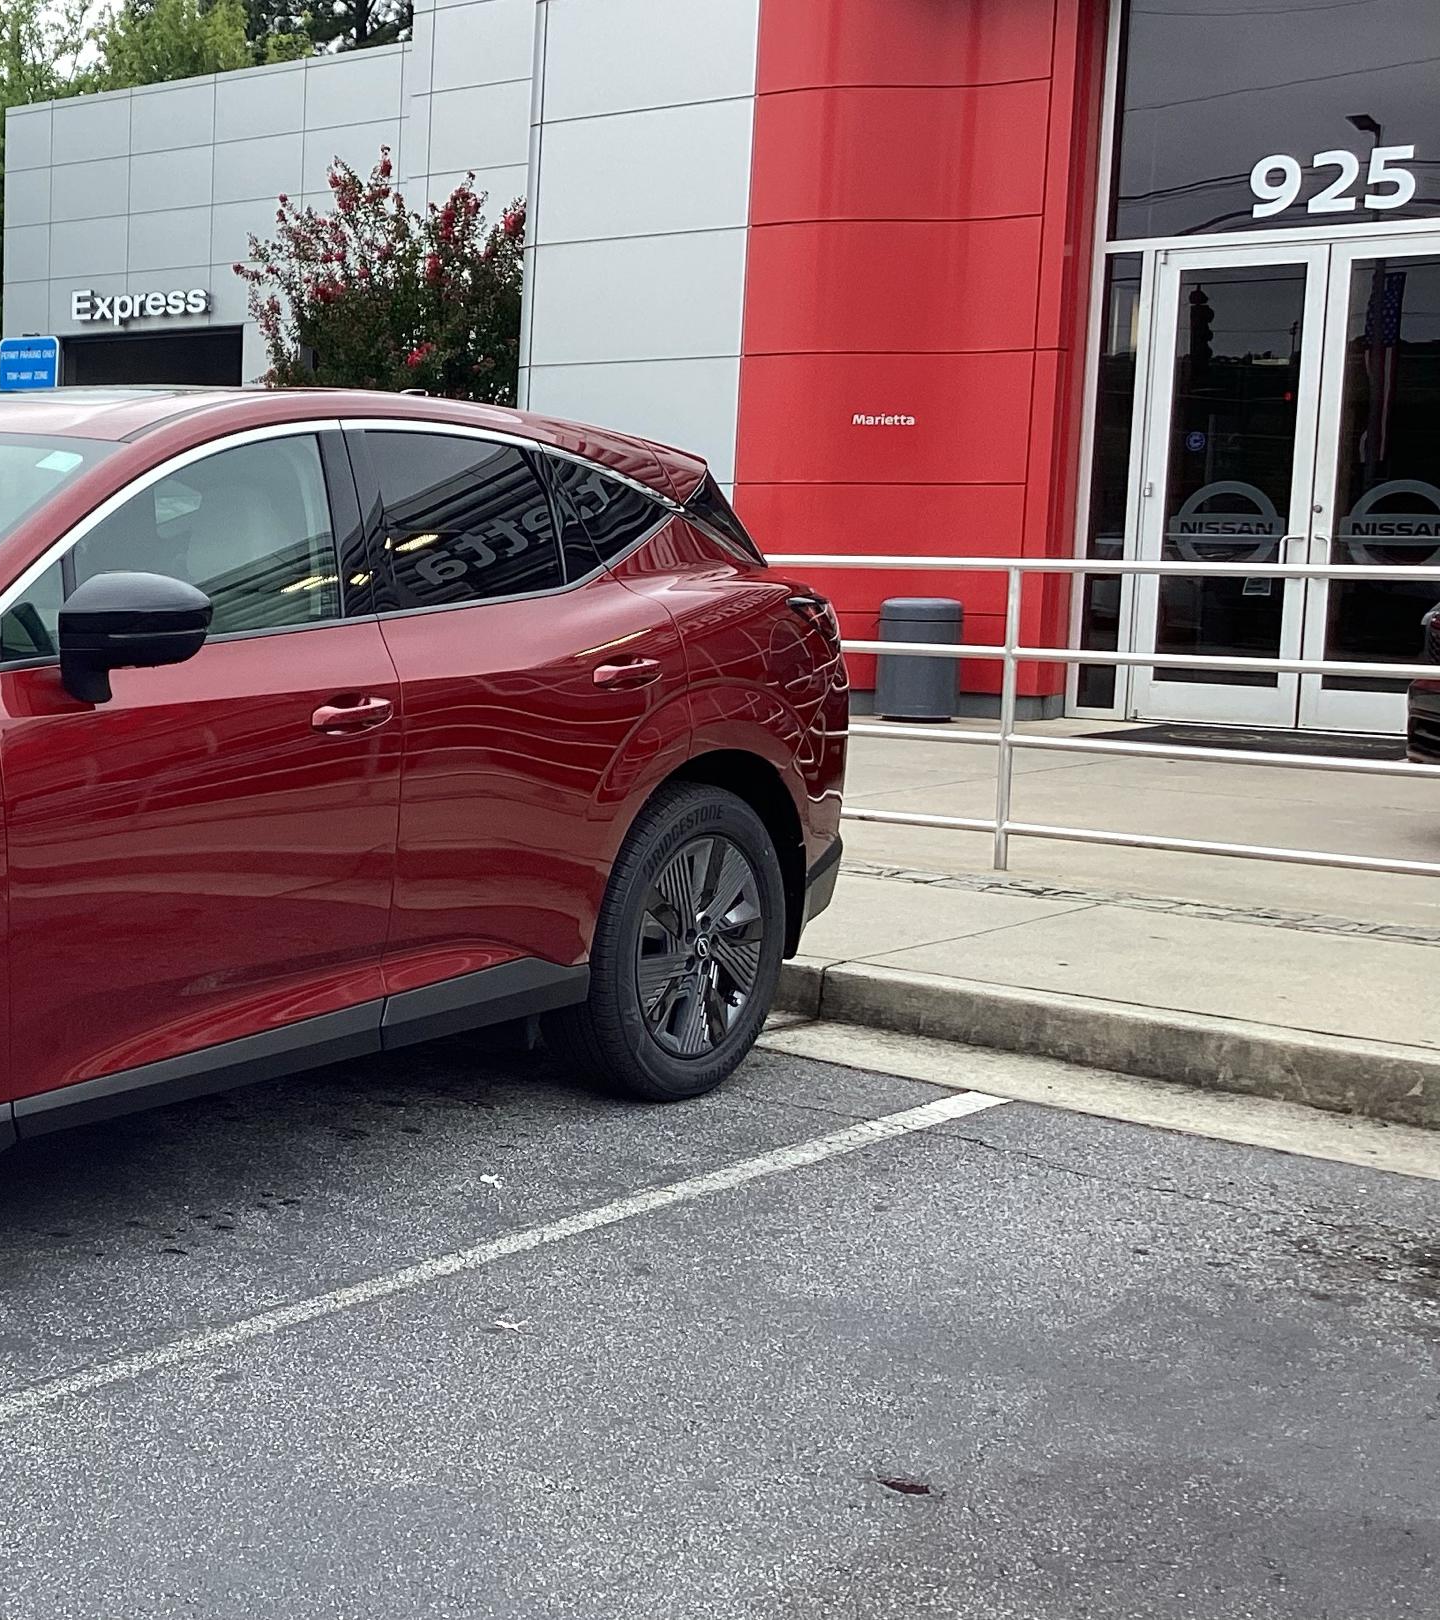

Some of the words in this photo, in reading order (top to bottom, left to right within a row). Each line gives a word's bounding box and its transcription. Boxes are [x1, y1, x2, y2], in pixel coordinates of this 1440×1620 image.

[1250, 145, 1416, 219] 925
[71, 289, 207, 326] Express
[852, 413, 915, 426] Marietta
[1180, 521, 1273, 535] NISSAN
[643, 804, 724, 882] BRIDGESTONE
